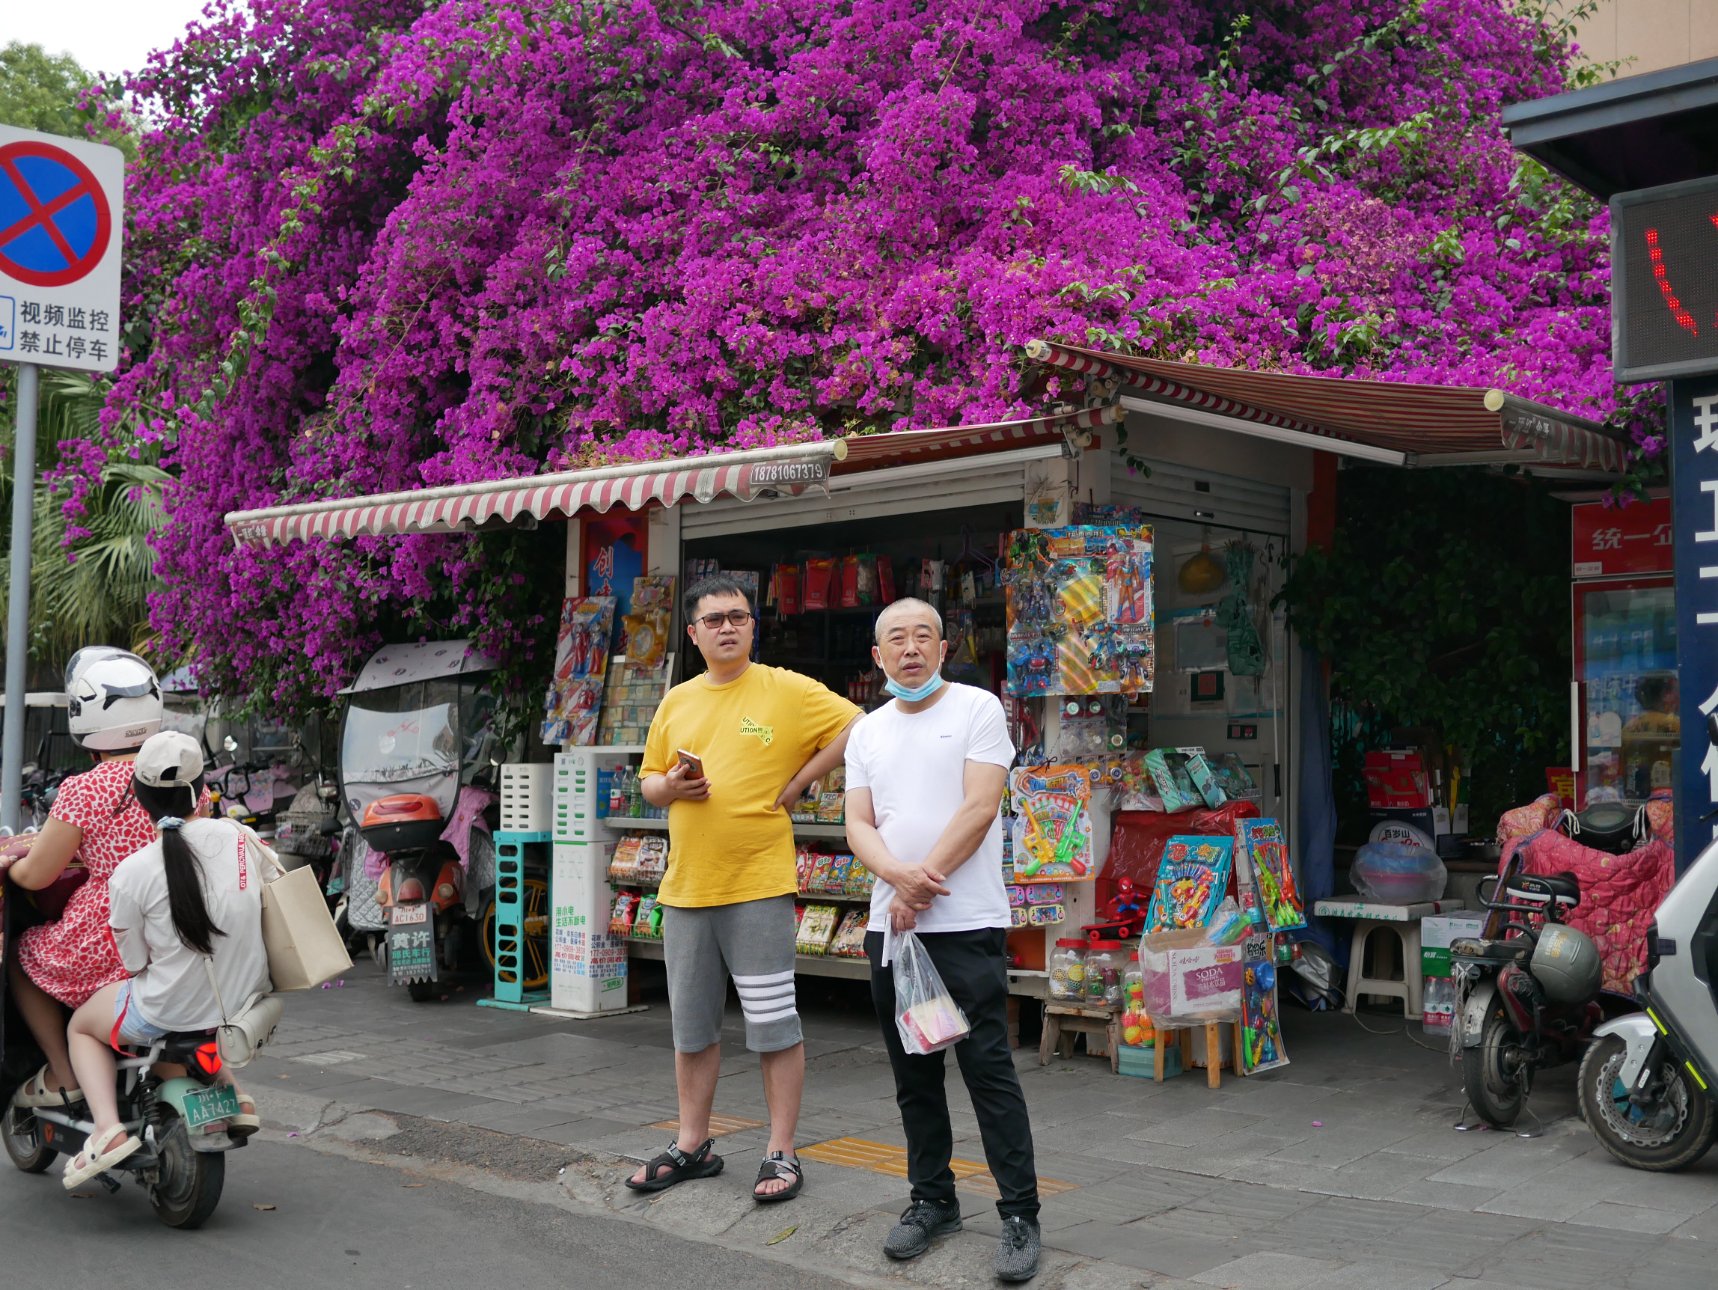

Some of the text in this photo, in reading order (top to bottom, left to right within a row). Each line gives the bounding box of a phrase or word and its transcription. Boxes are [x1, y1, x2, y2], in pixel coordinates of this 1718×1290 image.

[20, 300, 109, 332] 视频监控
[20, 330, 109, 362] 禁止停车
[754, 463, 823, 481] 18781067379
[1385, 829, 1410, 839] 百岁山
[1195, 967, 1223, 980] SODA
